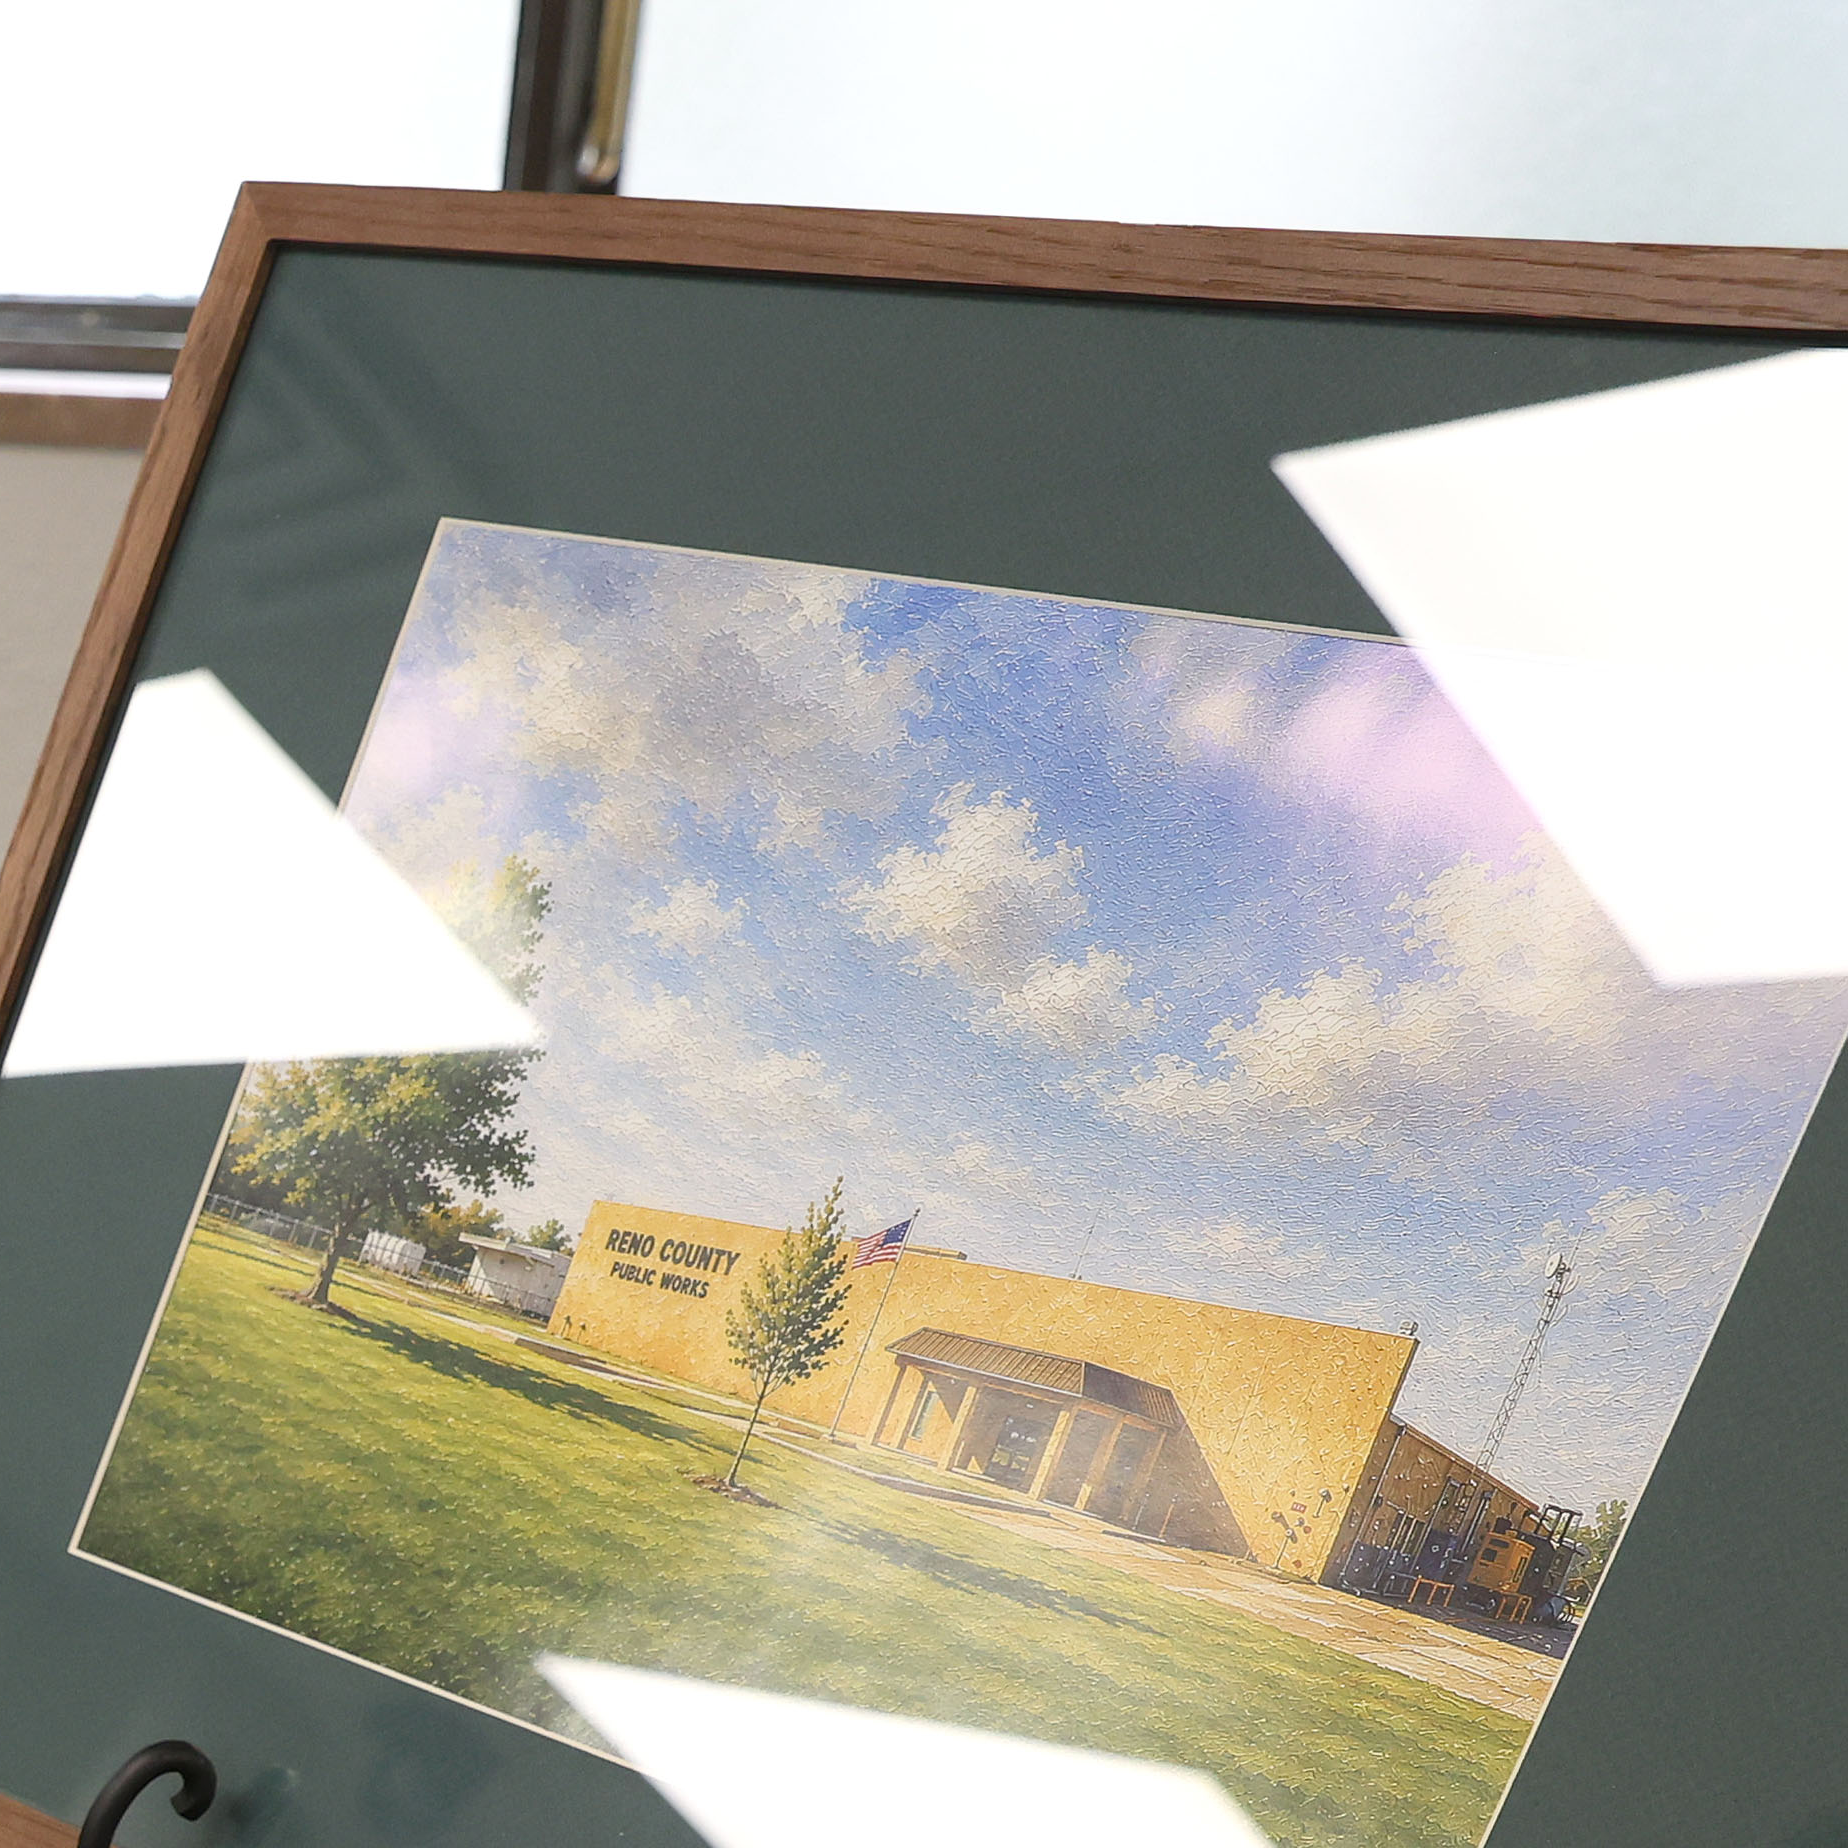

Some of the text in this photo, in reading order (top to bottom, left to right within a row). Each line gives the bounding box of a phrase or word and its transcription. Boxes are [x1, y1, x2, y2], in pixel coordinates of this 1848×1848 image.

[605, 1228, 742, 1276] RENO COUNTY
[610, 1261, 711, 1299] PUBLIC WORKS
